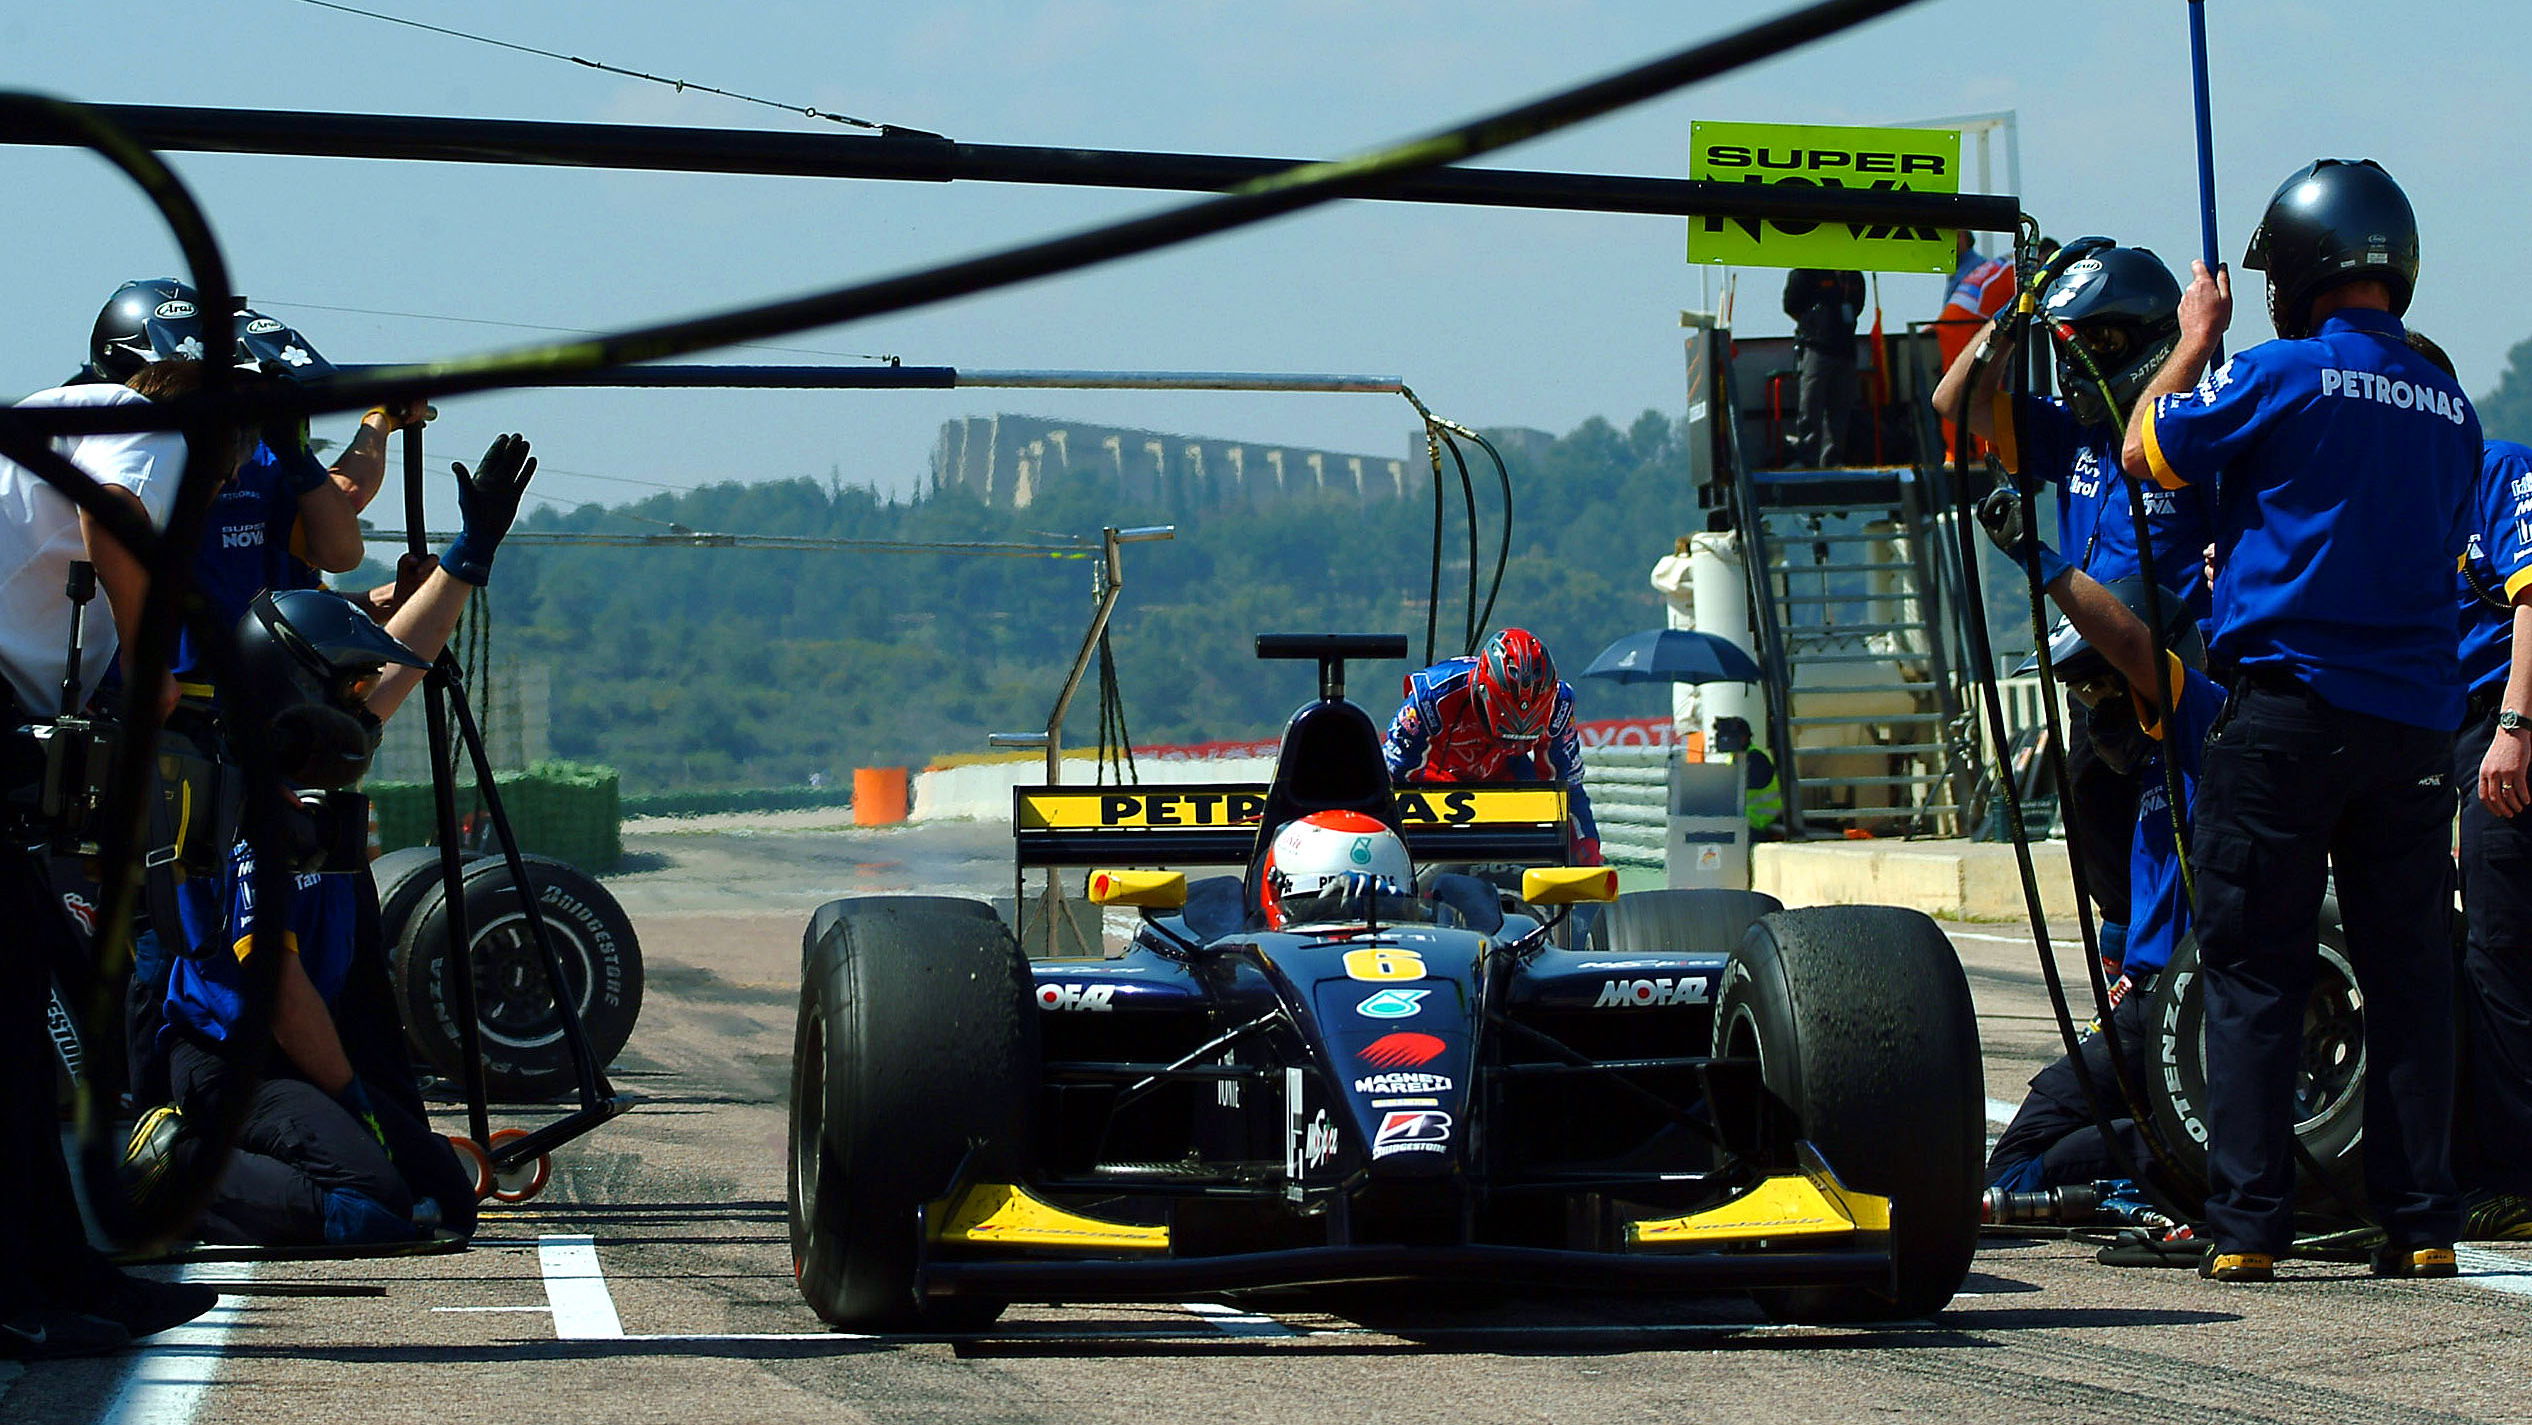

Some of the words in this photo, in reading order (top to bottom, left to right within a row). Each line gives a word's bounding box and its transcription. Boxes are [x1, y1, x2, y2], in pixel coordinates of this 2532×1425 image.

[1707, 145, 1946, 175] SUPER
[2321, 368, 2465, 425] PETRONAS
[1100, 792, 1476, 826] PETRAS
[540, 884, 625, 1008] BRIDGESTONE
[1342, 948, 1428, 982] 6
[1036, 983, 1115, 1011] OFAZ
[1593, 976, 1710, 1008] MOFAZ
[2161, 971, 2209, 1151] OTENZA
[1354, 1080, 1453, 1093] MARELLI
[1372, 1143, 1447, 1161] BRIDGESTONE
